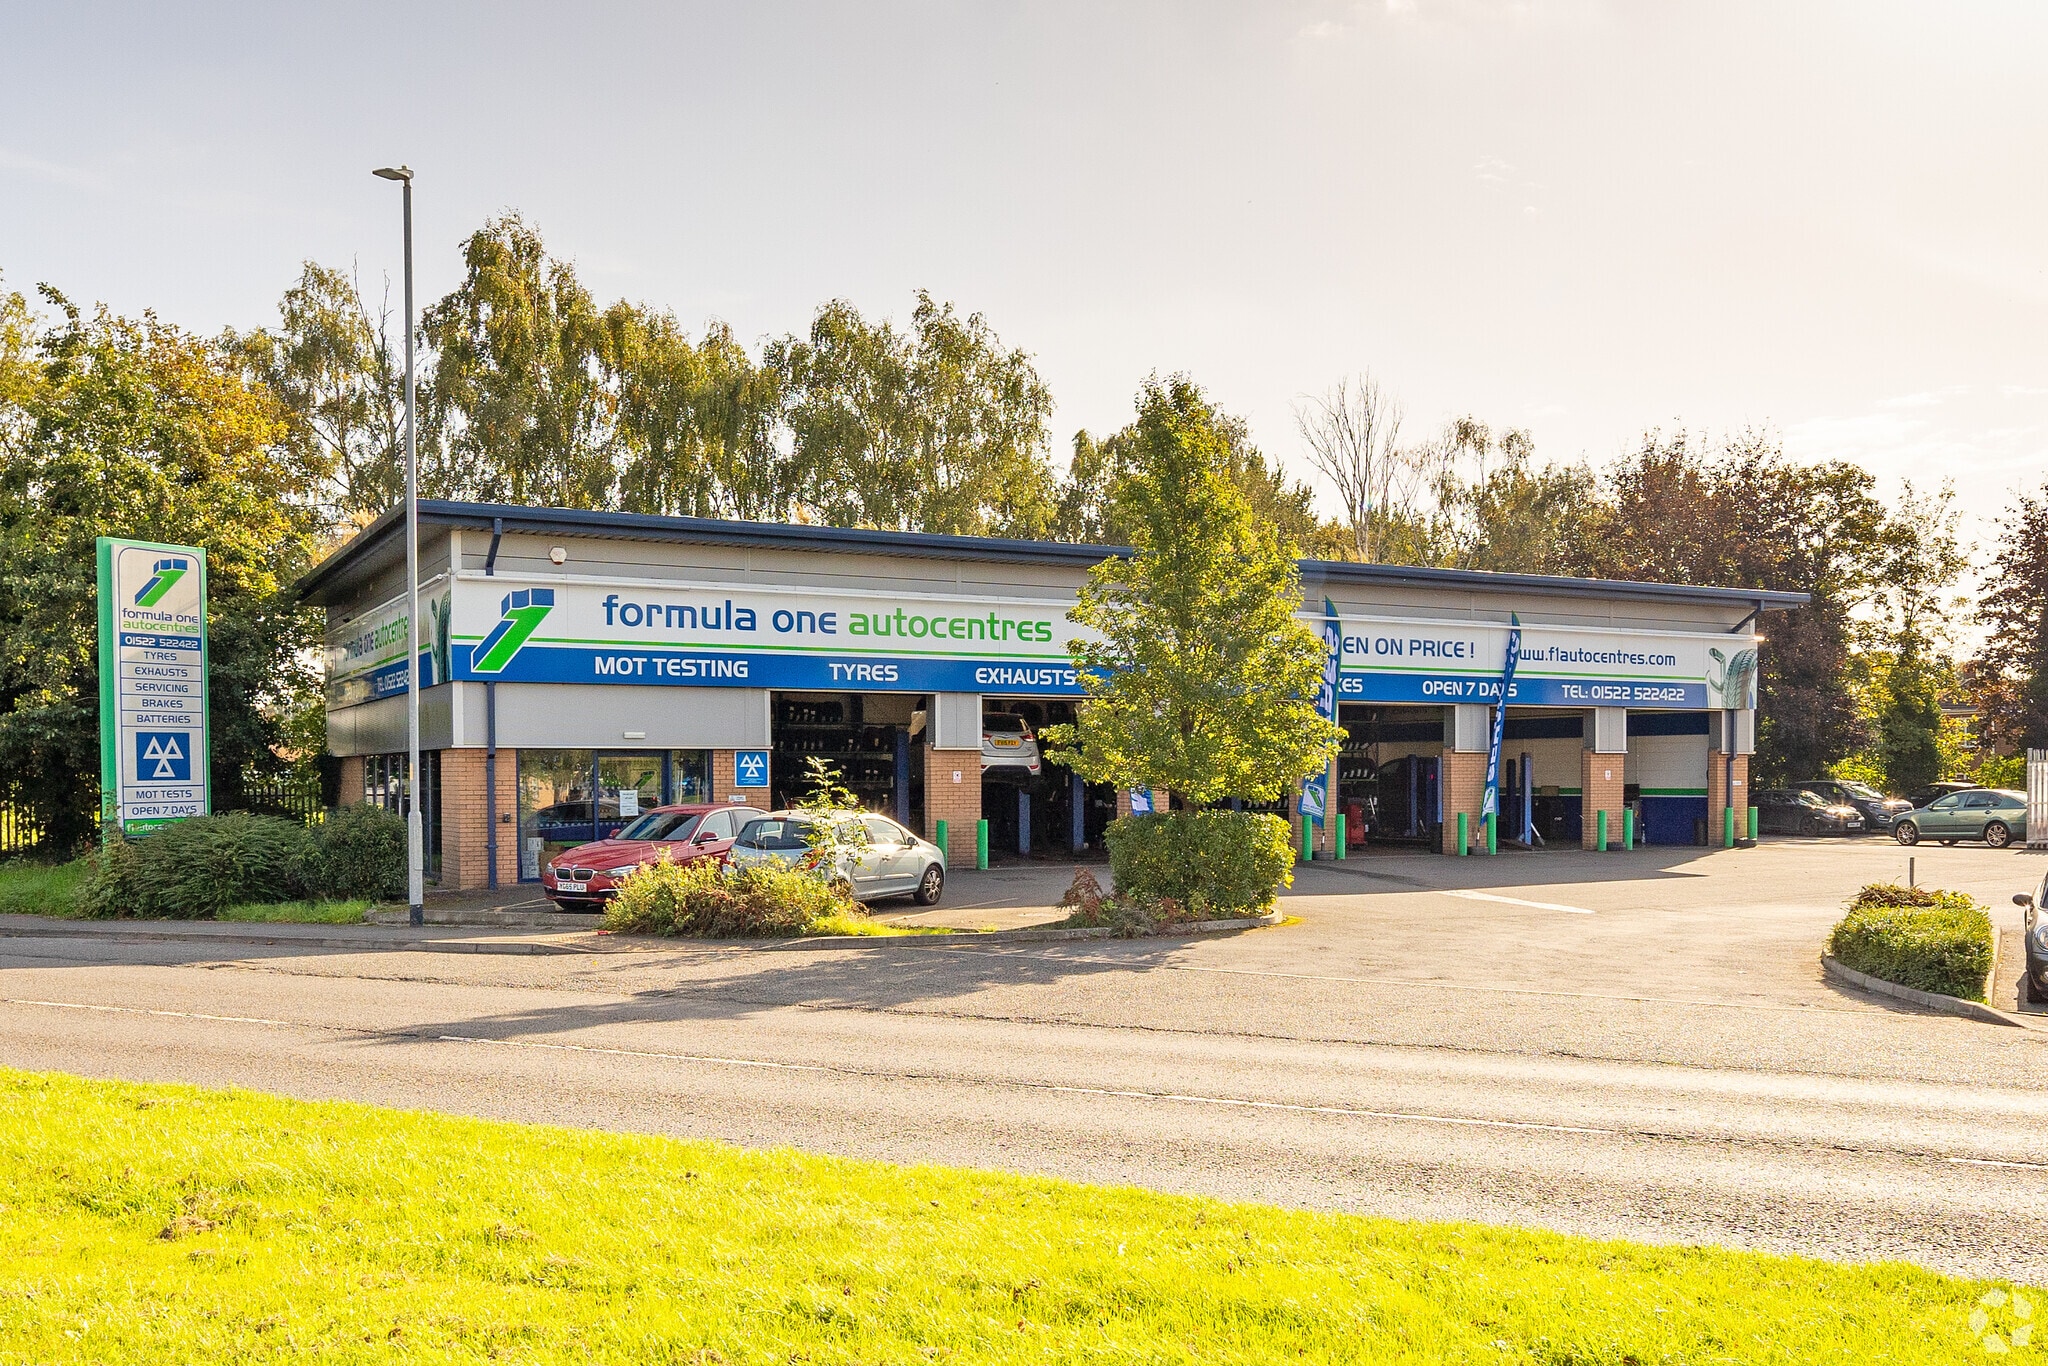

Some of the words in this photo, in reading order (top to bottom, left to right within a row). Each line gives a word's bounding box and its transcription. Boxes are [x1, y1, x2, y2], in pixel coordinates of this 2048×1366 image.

[122, 608, 173, 622] formula
[176, 614, 199, 624] one
[602, 594, 757, 632] formula
[772, 609, 837, 635] one
[849, 607, 1053, 642] autocentres
[123, 620, 199, 634] autocentres
[375, 612, 409, 650] autocentre
[125, 636, 156, 646] 01522
[159, 638, 198, 649] 522422
[1342, 636, 1369, 655] EN
[1375, 638, 1403, 656] ON
[1410, 639, 1465, 658] PRICE
[144, 651, 177, 661] TYRES
[1506, 646, 1677, 666] ww.f1autocentres.com
[134, 666, 188, 678] EXHAUSTS
[595, 656, 647, 675] MOT
[652, 658, 748, 679] TESTING
[829, 663, 899, 682] TYRES
[975, 667, 1077, 687] EXHAUSTS
[135, 682, 189, 694] SERVICING
[1422, 680, 1463, 696] OPEN
[1466, 682, 1476, 696] 7
[1479, 682, 1518, 698] DAS
[1561, 684, 1588, 699] TEL:
[1591, 685, 1631, 700] 01522
[1634, 687, 1685, 701] 522422
[141, 698, 184, 709] BRAKES
[136, 714, 191, 724] BATTERIES
[136, 790, 158, 799] MOT
[161, 789, 192, 799] TESTS
[132, 806, 160, 816] OPEN
[162, 806, 169, 815] 7
[171, 805, 197, 816] DAYS
